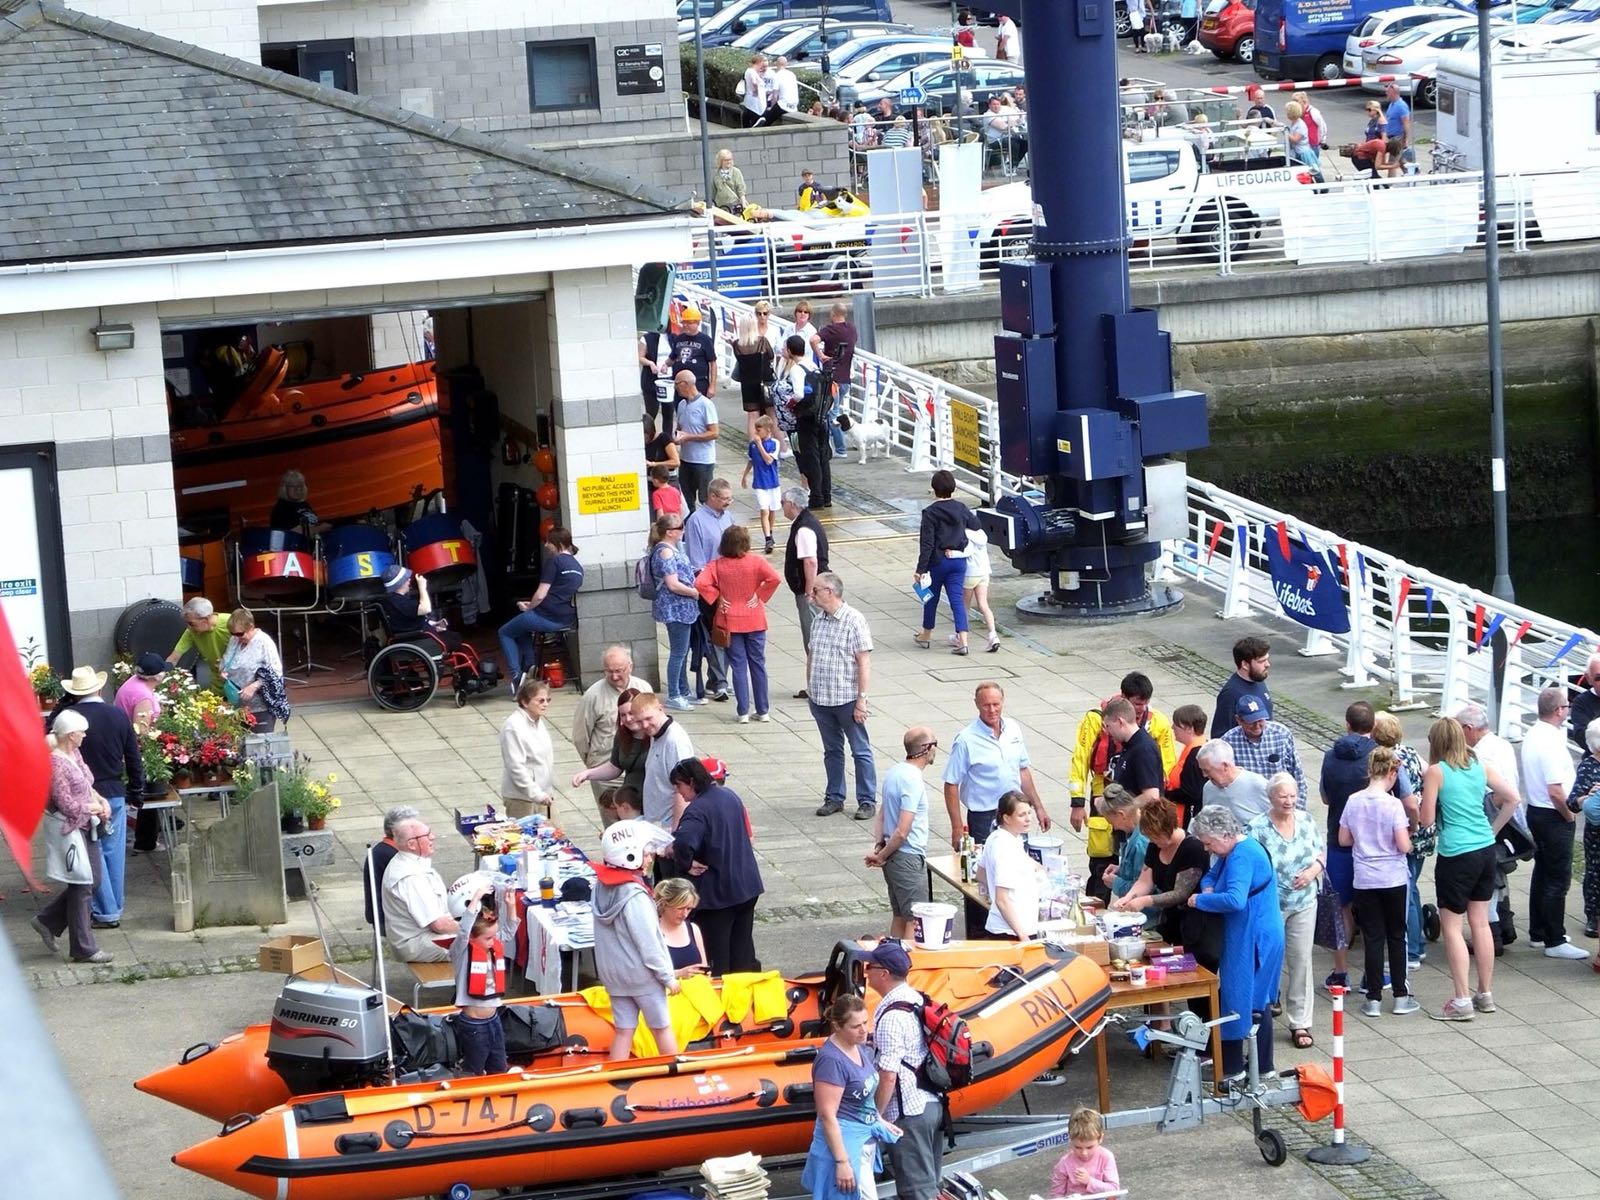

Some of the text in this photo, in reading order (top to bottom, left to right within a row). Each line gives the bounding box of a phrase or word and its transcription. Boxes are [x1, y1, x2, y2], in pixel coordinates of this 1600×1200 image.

[1216, 170, 1292, 187] LIFEGUARD
[607, 496, 633, 504] LIFEBOAT
[356, 553, 374, 577] S
[441, 542, 461, 563] T
[14, 579, 32, 587] exit
[611, 827, 634, 844] RNLI
[1020, 978, 1078, 1028] RNLI
[280, 1008, 358, 1028] MARINER 50
[412, 1093, 518, 1131] D-747
[1036, 1132, 1069, 1149] snipe
